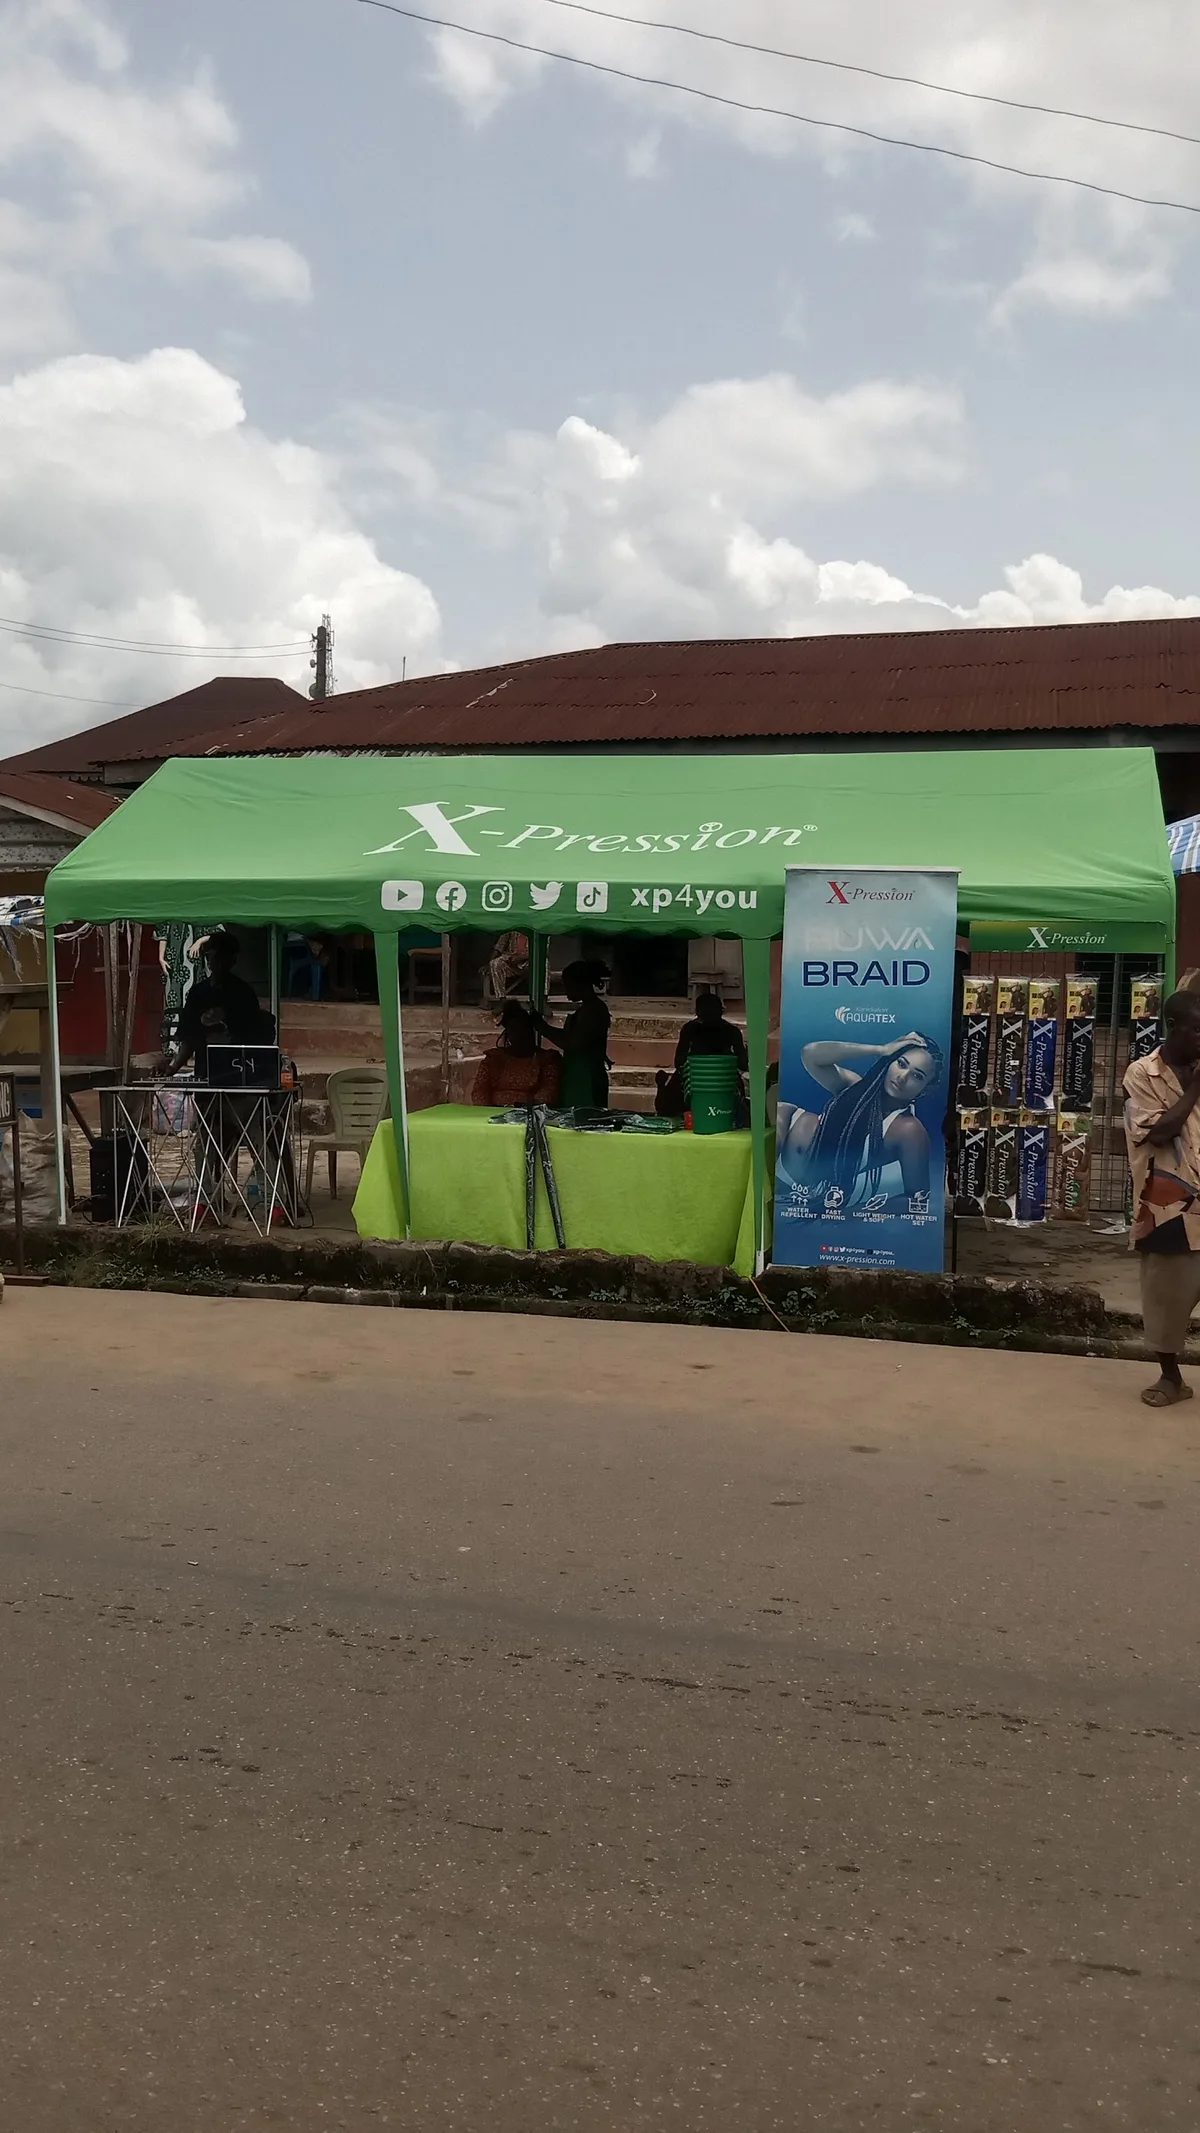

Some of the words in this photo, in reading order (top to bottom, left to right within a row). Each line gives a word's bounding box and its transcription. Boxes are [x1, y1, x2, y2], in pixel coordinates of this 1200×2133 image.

[630, 883, 758, 915] xp4you
[802, 960, 931, 987] BRAID
[846, 1012, 896, 1024] AQUATEX
[1033, 1020, 1053, 1091] X-Pression
[1072, 1021, 1093, 1092] X-Pression
[1023, 1130, 1044, 1200] X-Pression
[780, 1211, 817, 1219] REPELLENT
[819, 1254, 895, 1265] www.x-pression.com
